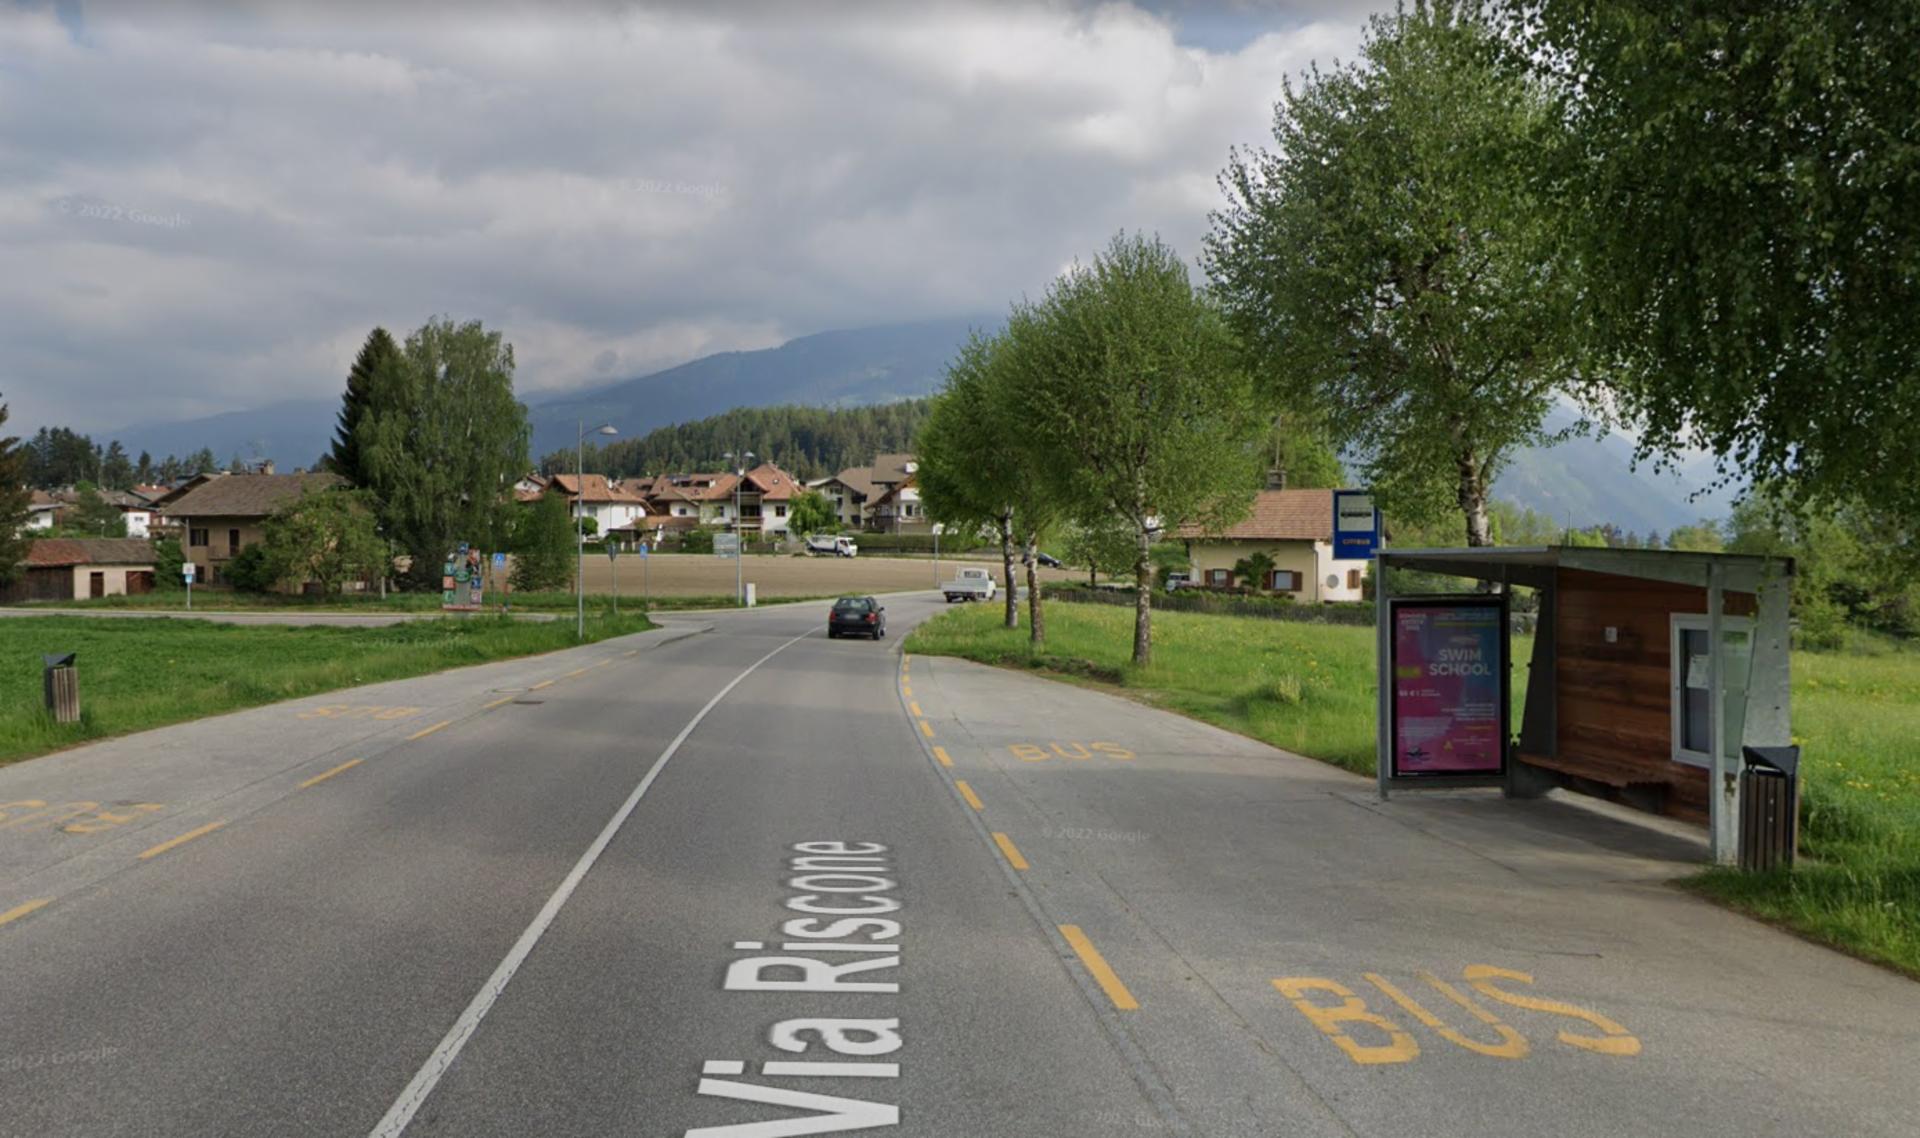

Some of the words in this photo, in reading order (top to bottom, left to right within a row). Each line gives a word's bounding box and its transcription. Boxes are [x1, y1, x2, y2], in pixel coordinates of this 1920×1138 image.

[1438, 648, 1482, 661] SWIM
[1428, 663, 1492, 676] SCHOOL
[1008, 740, 1137, 762] BUS
[1270, 964, 1642, 1065] BUS
